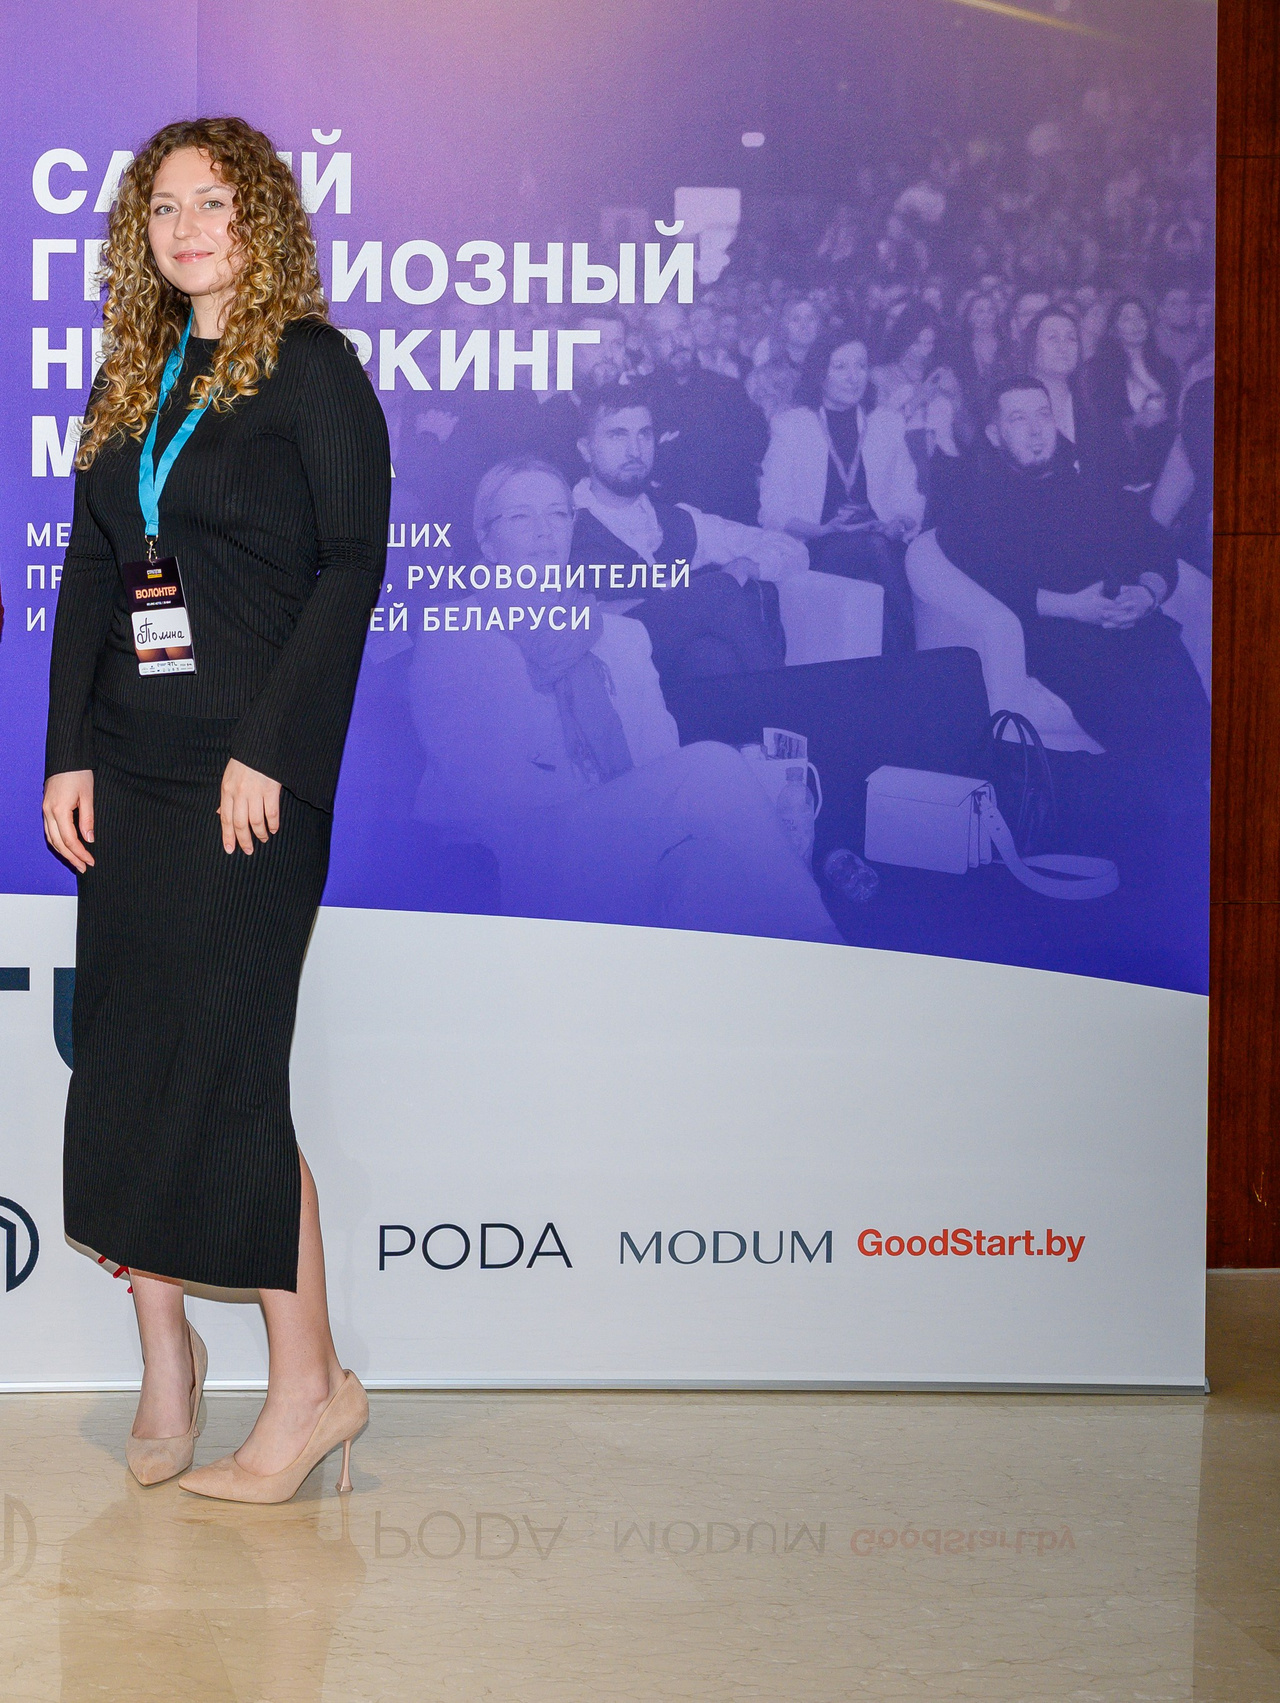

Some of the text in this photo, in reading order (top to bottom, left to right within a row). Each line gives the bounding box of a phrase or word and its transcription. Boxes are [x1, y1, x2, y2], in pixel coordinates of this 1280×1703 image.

[32, 219, 695, 305] ГИОЗНЫЙ
[407, 559, 691, 591] РУКОВОДИТЕЛЕЙ
[135, 586, 176, 599] ВОЛОНТЕР
[26, 607, 46, 631] И
[137, 617, 184, 644] Полина
[423, 605, 592, 632] БЕЛАРУСИ
[378, 1221, 573, 1271] PODA
[620, 1230, 834, 1265] MODUM
[857, 1227, 1087, 1263] GoodStart.by
